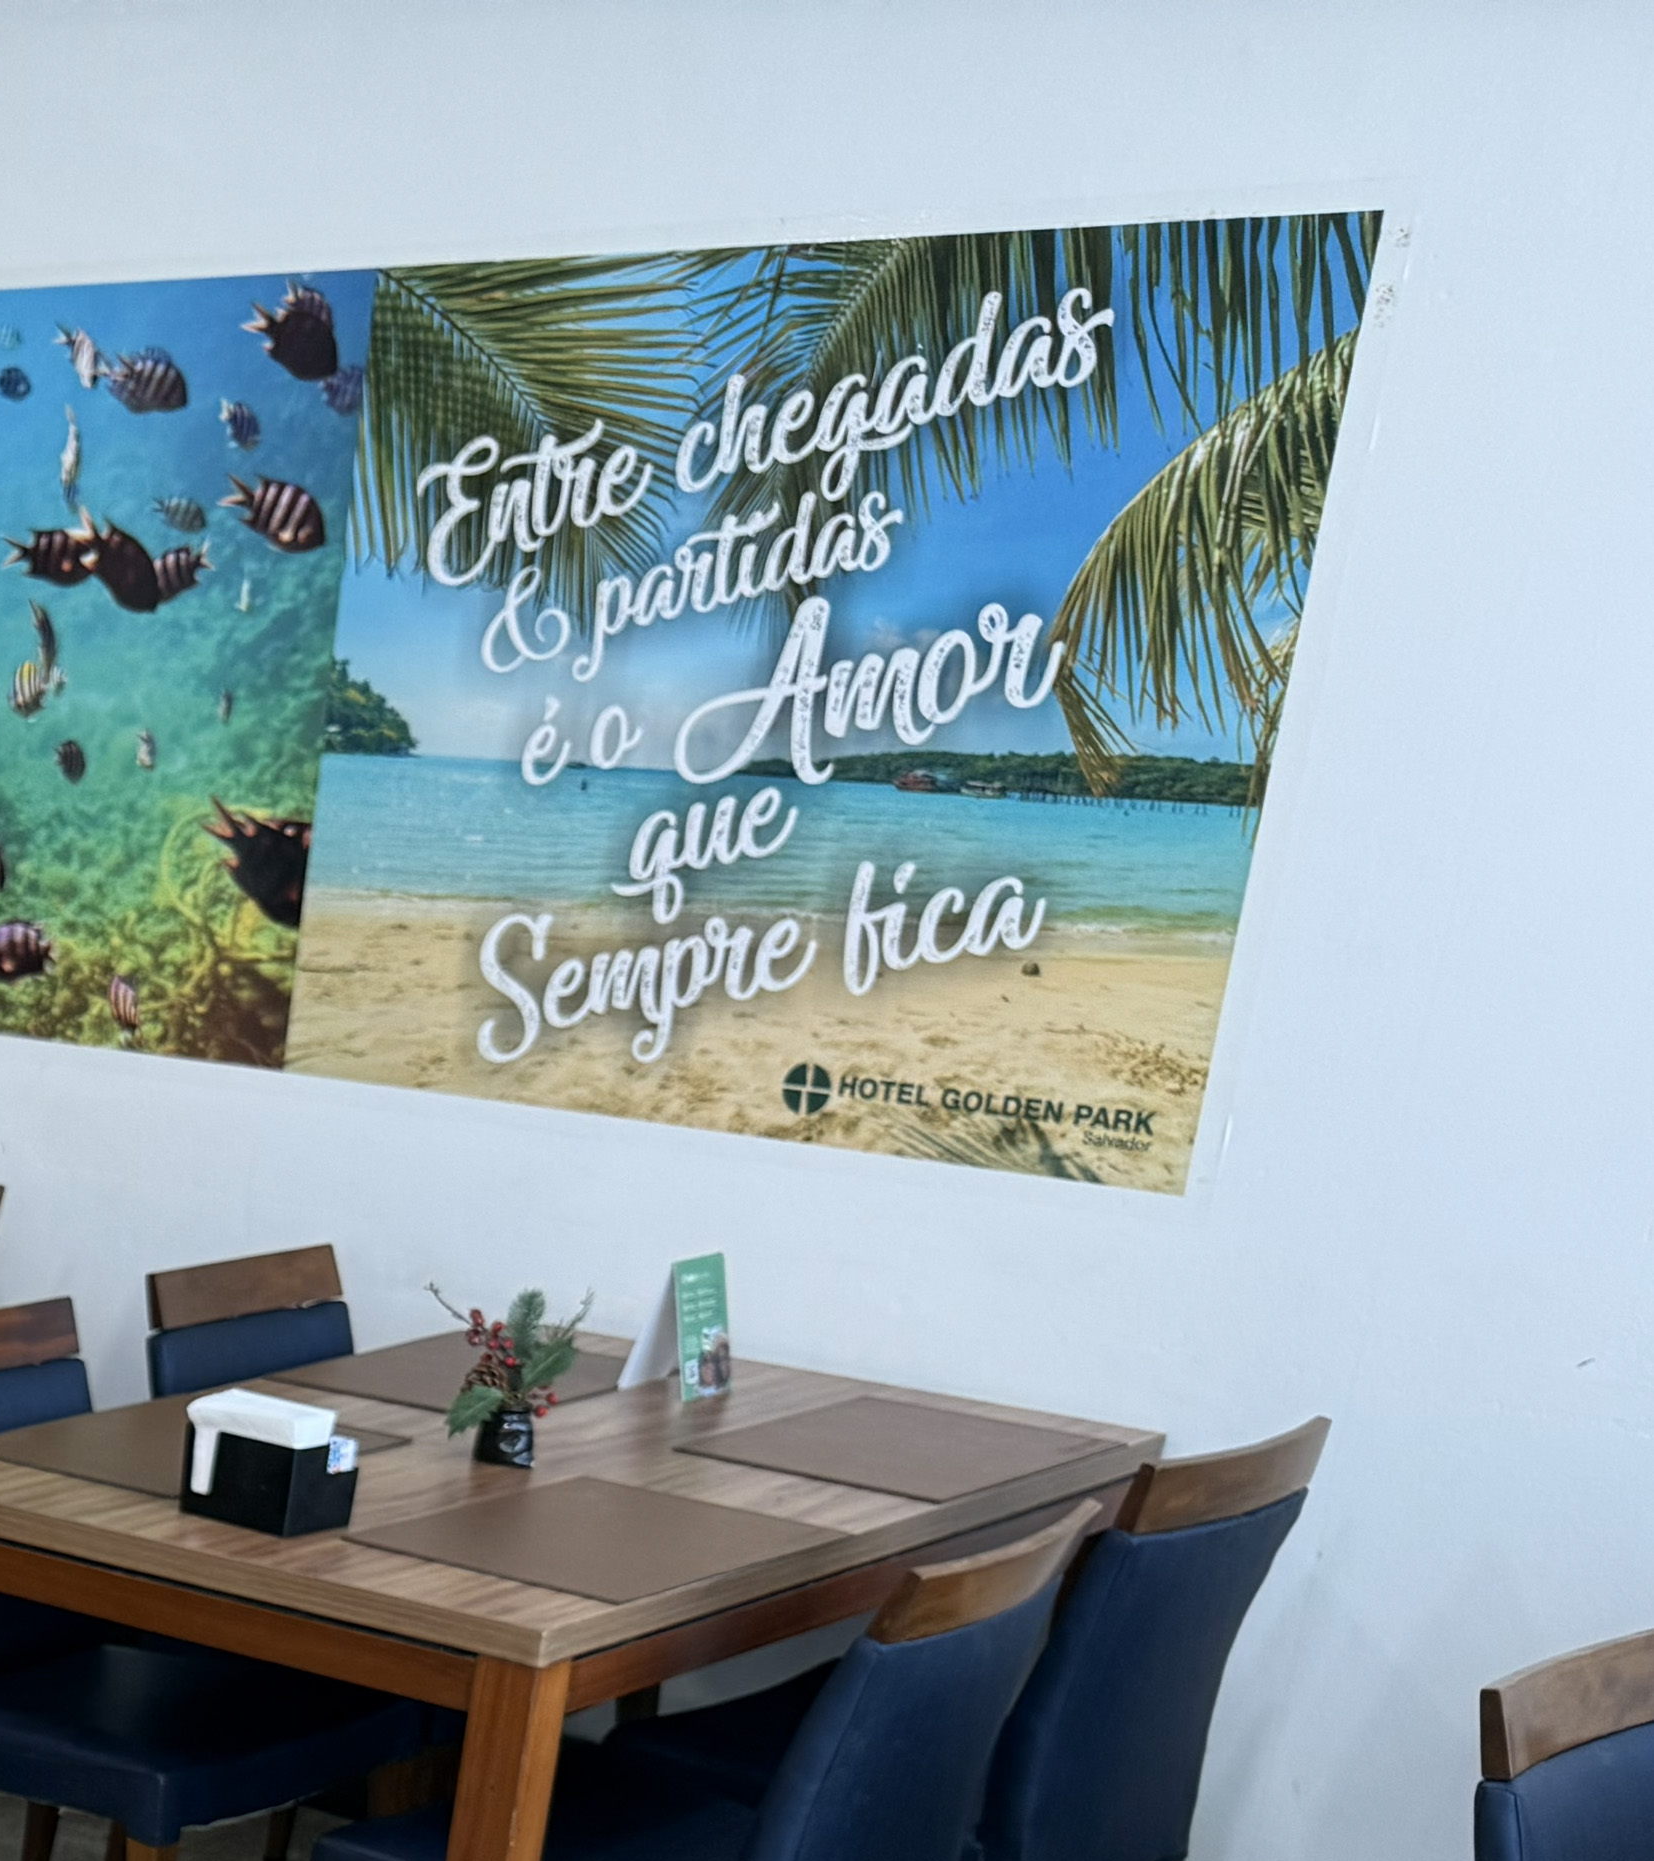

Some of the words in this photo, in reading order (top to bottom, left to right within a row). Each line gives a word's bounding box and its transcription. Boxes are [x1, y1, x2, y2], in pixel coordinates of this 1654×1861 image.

[418, 419, 651, 586] Entre
[675, 287, 1114, 501] chegadas
[572, 491, 903, 682] partidas
[521, 696, 571, 786] é
[591, 706, 643, 769] o
[674, 596, 1065, 784] Amor
[611, 786, 798, 923] que
[477, 914, 817, 1062] Sempre
[843, 861, 1045, 995] fica
[839, 1075, 930, 1107] HOTEL
[942, 1088, 1064, 1124] GOLDEN
[1074, 1104, 1156, 1136] PARK
[1082, 1130, 1151, 1151] Salvador
